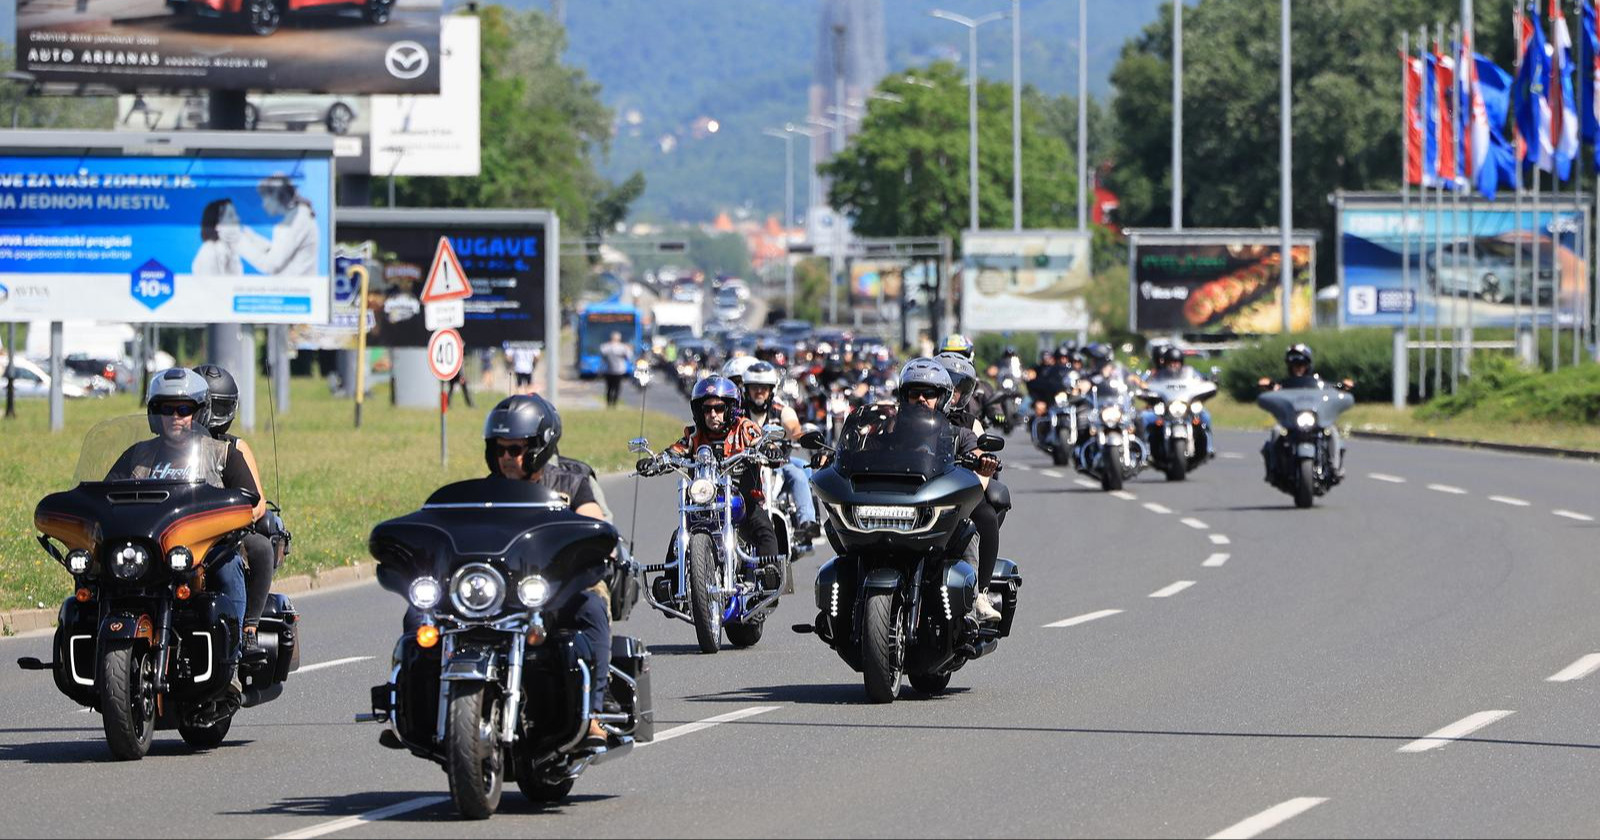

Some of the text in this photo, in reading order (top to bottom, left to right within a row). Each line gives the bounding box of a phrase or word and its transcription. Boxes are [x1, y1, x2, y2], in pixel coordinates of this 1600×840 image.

[28, 47, 75, 63] AUTO
[80, 49, 160, 66] ARBANAS
[26, 173, 51, 188] ZA
[53, 167, 99, 189] VAŠE
[19, 194, 94, 210] JEDNOM
[96, 195, 170, 211] MJESTU.
[436, 341, 455, 366] 40
